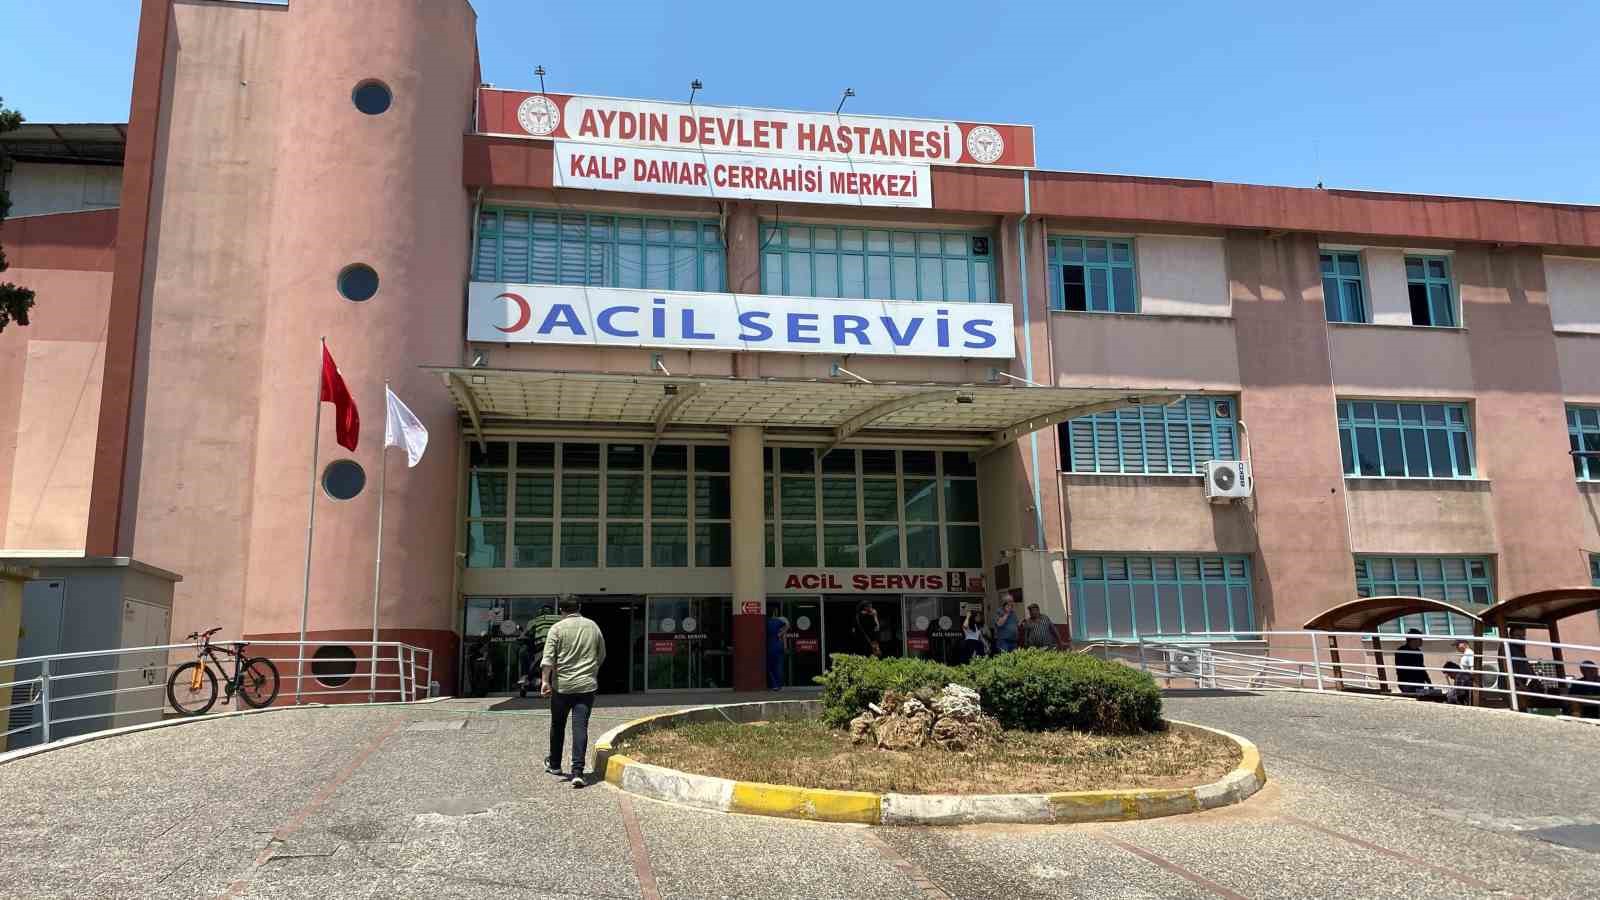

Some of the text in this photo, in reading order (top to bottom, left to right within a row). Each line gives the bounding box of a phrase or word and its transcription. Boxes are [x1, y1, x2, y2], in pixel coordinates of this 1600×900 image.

[579, 109, 669, 141] AYDIN
[679, 117, 787, 148] DEVLET
[797, 124, 951, 160] HASTANESİ
[570, 153, 918, 198] KALP DAMAR CERRAHİSİ MERKEZİ
[538, 297, 997, 349] ACİL SERVİS
[785, 574, 943, 590] ACİL SERVİS
